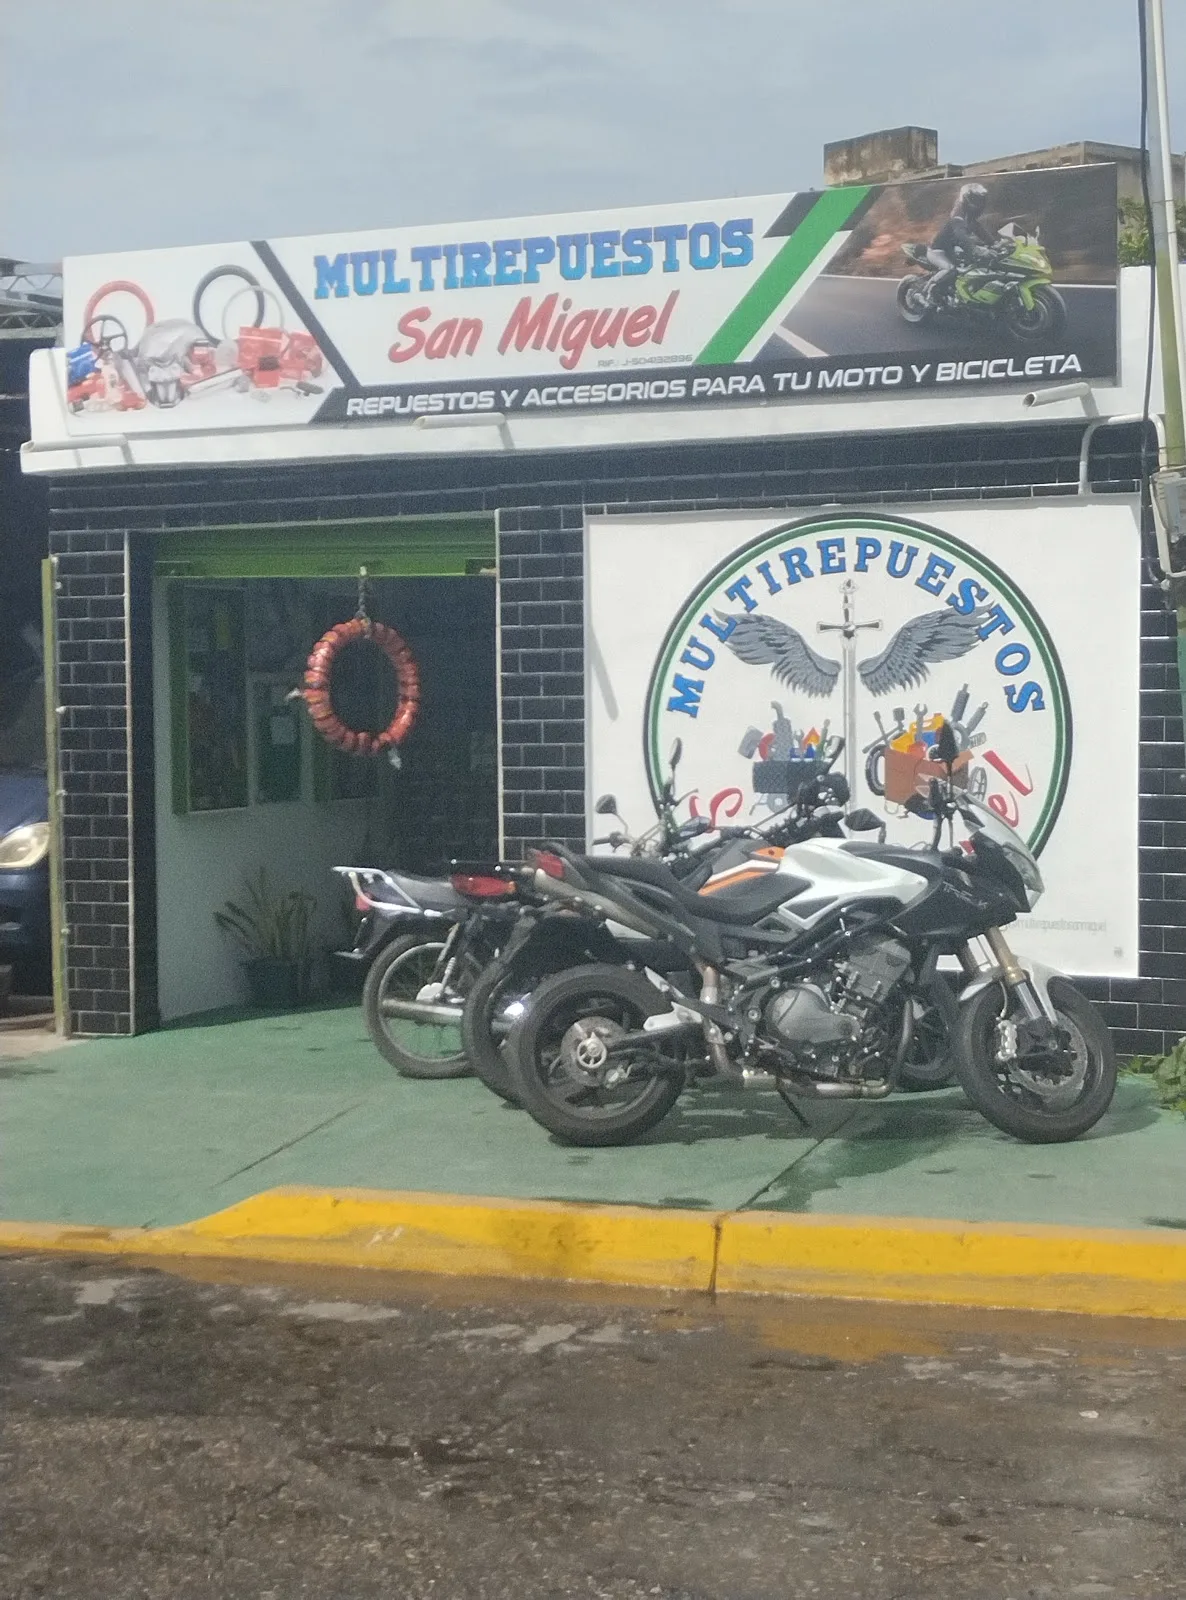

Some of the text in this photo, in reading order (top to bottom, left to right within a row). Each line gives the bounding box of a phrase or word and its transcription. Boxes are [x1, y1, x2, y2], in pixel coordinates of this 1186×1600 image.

[313, 218, 754, 300] MULTIREPUESTOS
[388, 288, 680, 371] San Miguel
[347, 353, 1083, 417] REPUESTOS Y ACCESORIOS PARA TU MOTO Y BICICLETA
[667, 537, 1045, 719] MULTIREPUESTOS
